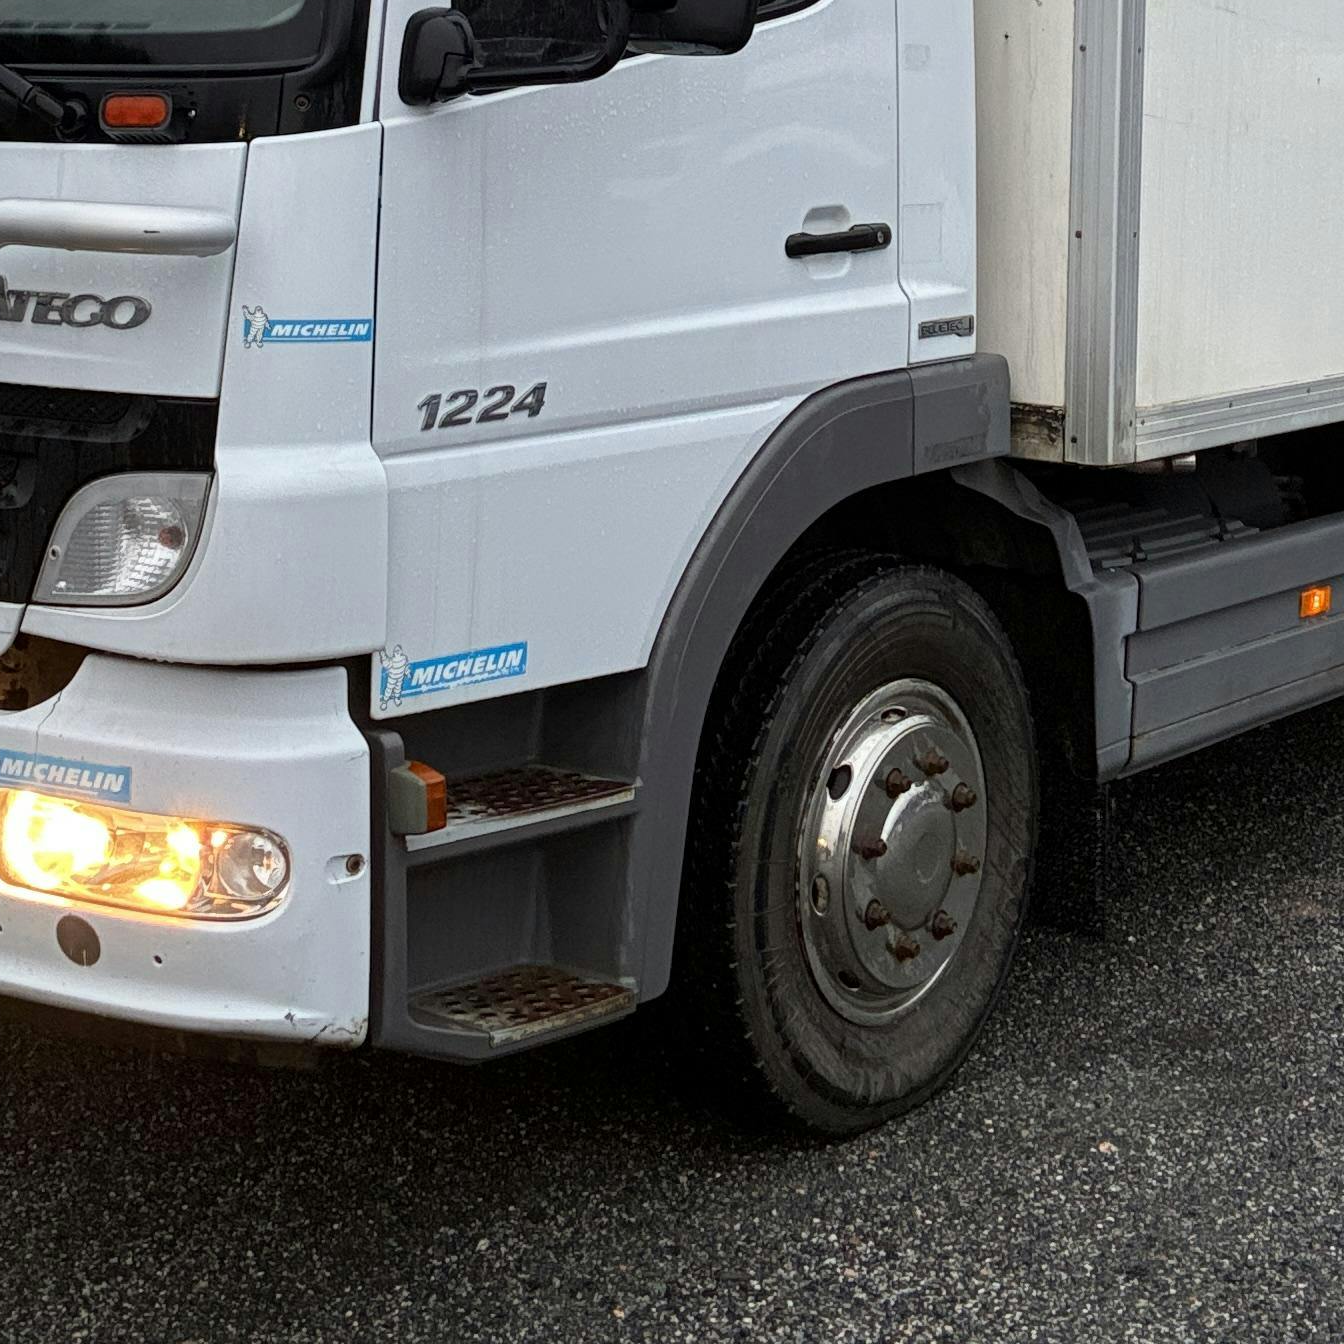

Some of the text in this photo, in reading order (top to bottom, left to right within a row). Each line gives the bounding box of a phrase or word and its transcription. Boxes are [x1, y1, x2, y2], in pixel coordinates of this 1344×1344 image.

[271, 323, 369, 336] MICHELIN
[417, 381, 548, 431] 1224
[411, 649, 523, 685] MICHELIN
[0, 758, 124, 793] MICHELIN
